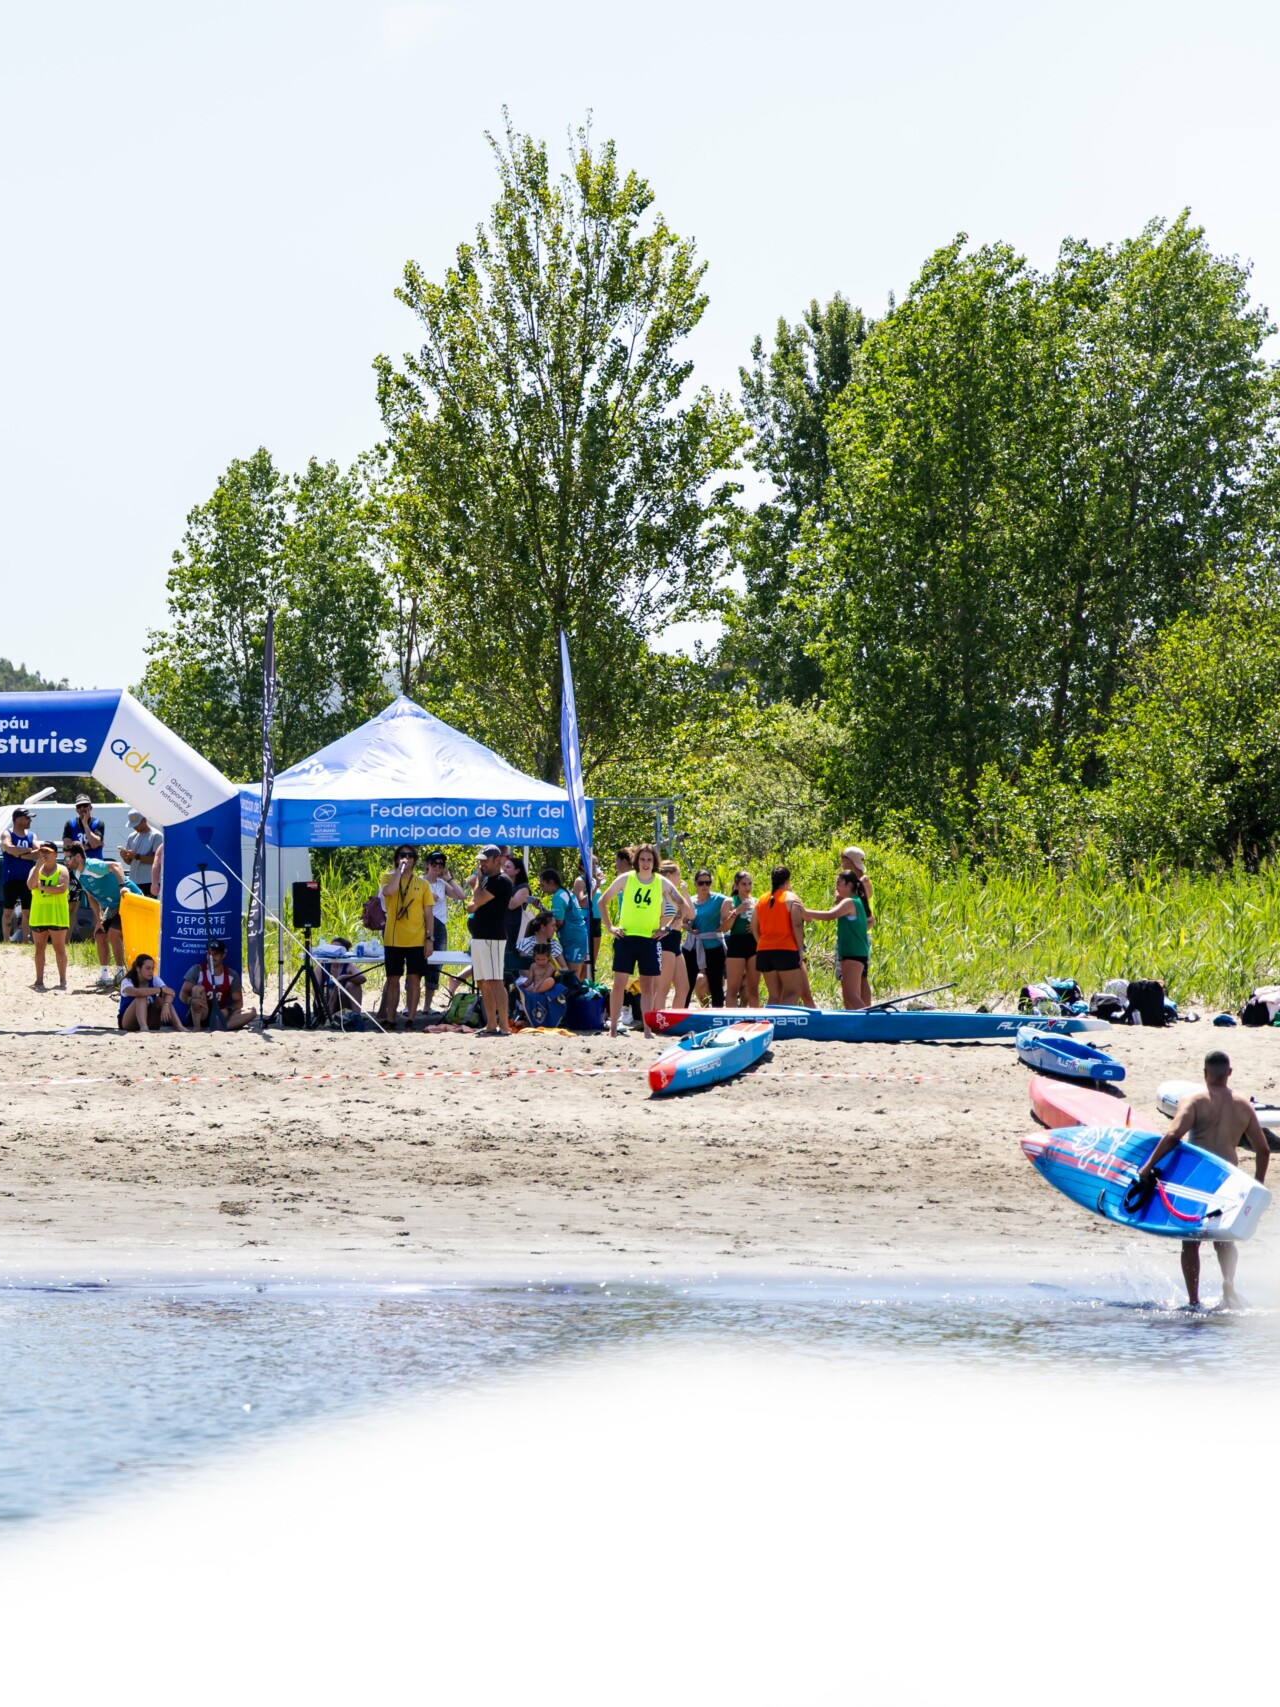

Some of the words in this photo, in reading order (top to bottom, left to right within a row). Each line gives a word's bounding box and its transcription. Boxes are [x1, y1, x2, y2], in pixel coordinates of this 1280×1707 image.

[165, 784, 188, 805] deporte
[159, 790, 190, 817] naturaleza
[370, 803, 468, 818] Federacion
[474, 803, 498, 818] de
[502, 803, 532, 818] Surf
[538, 804, 565, 819] del
[370, 824, 462, 840] Principado
[468, 824, 492, 838] de
[496, 824, 560, 839] Asturias
[634, 888, 651, 906] 64
[176, 915, 226, 925] DEPORTE
[712, 1016, 808, 1026] STOARD
